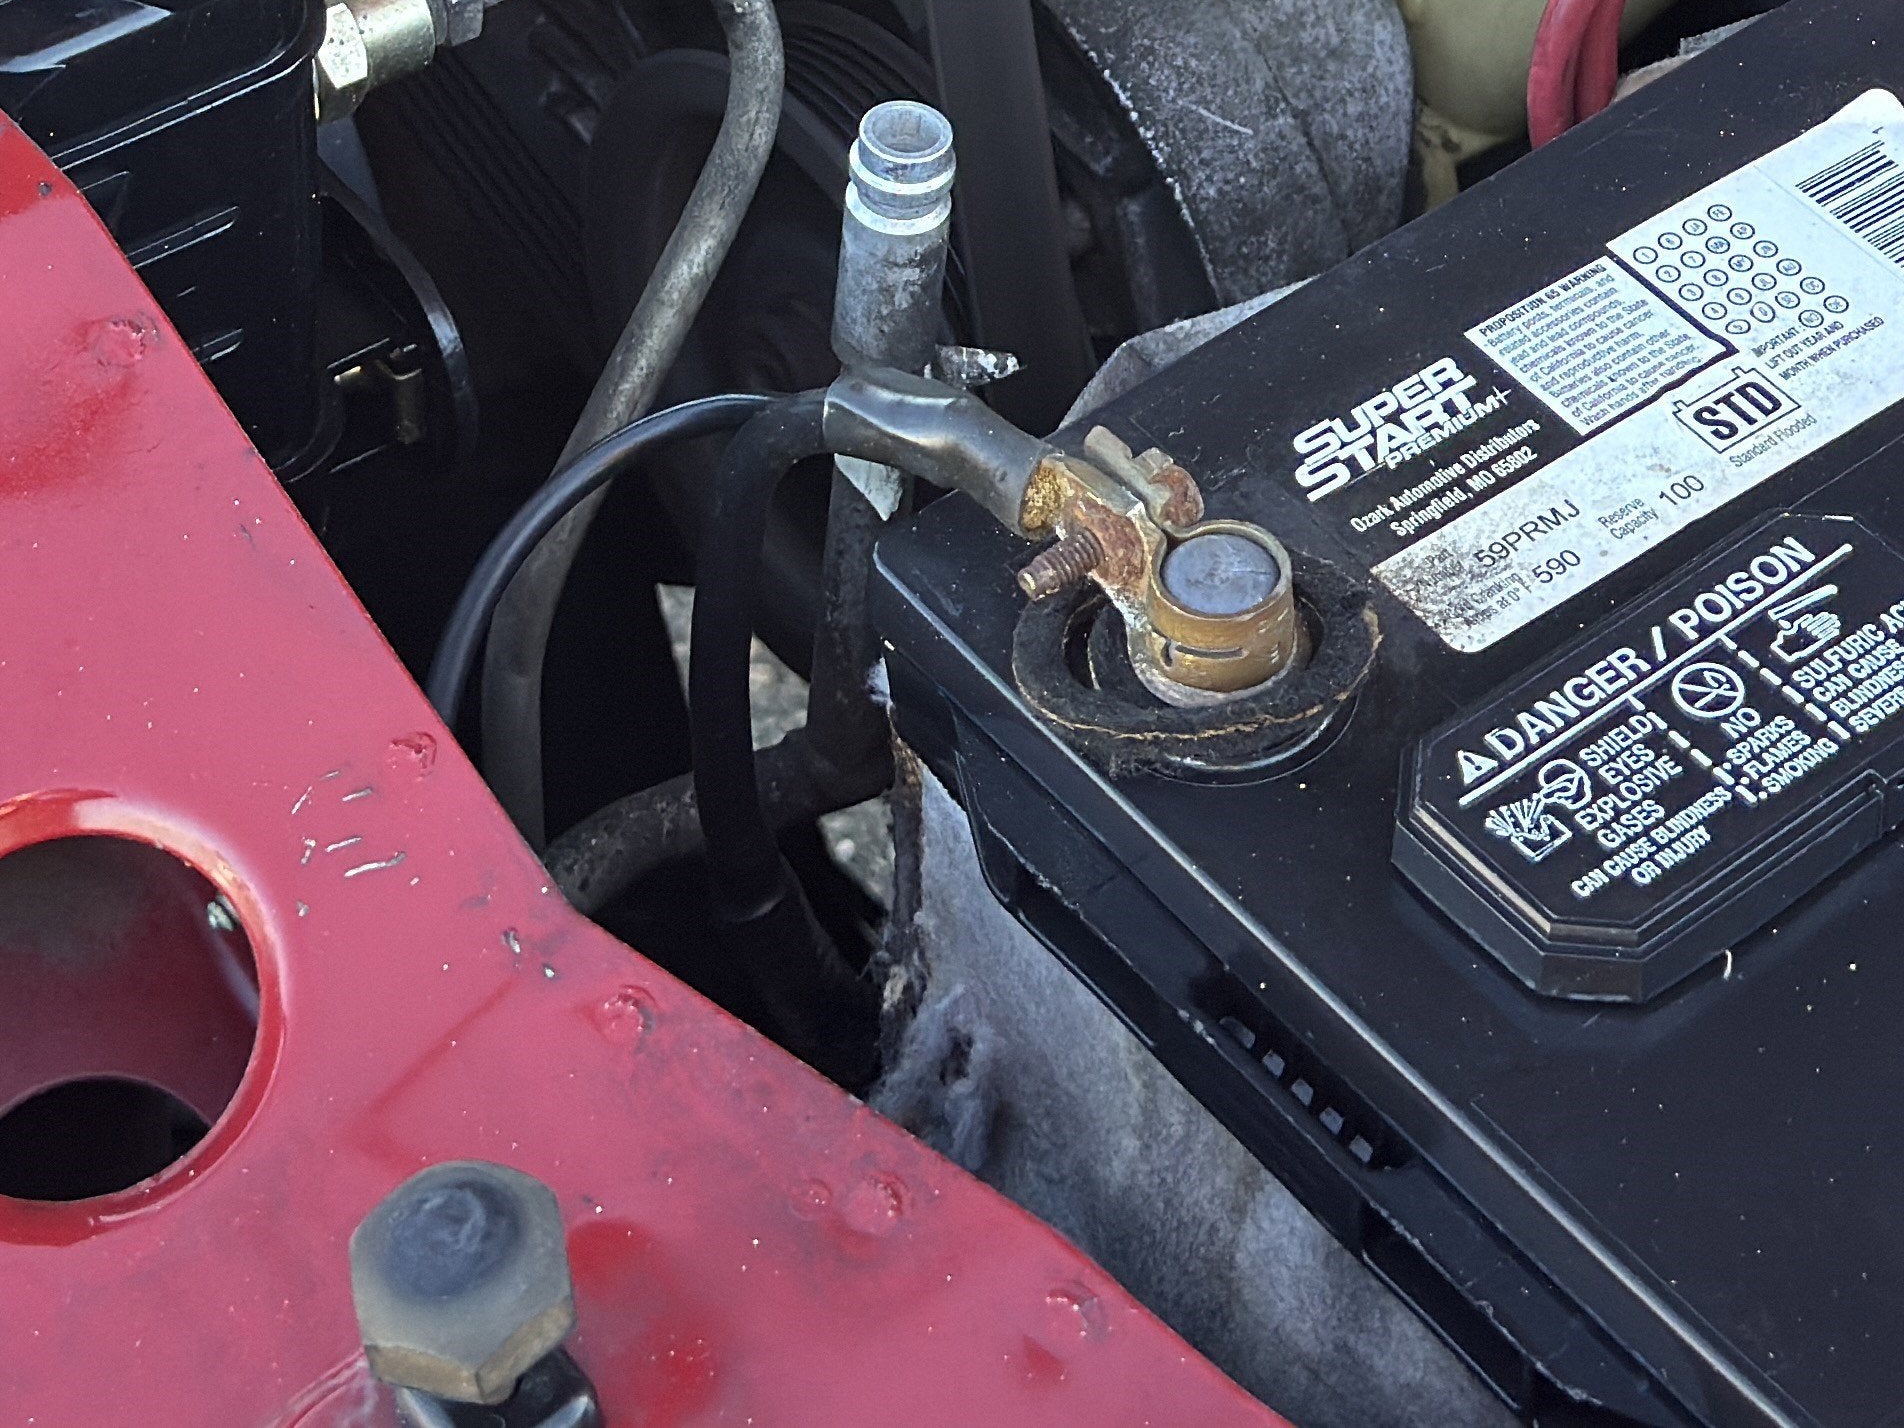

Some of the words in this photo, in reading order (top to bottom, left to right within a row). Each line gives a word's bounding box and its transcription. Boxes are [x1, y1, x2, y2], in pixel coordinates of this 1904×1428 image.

[1871, 126, 1883, 134] 1
[1478, 296, 1547, 337] PROPOSITION
[1544, 288, 1560, 299] 65
[1557, 264, 1606, 291] WARNING
[1764, 353, 1785, 369] LIFT
[1781, 343, 1803, 358] OUT
[1799, 331, 1826, 347] YEAR
[1823, 320, 1844, 335] AND
[1778, 358, 1811, 380] MONTH
[1807, 344, 1836, 362] WHEN
[1832, 316, 1884, 349] PURCHASED
[1292, 355, 1467, 459] SUPER
[1692, 381, 1782, 440] STD
[1295, 373, 1477, 502] START
[1728, 434, 1778, 467] Standard
[1772, 412, 1817, 441] Flooded
[1350, 504, 1394, 532] Ozark
[1389, 462, 1465, 511] Automotive
[1459, 419, 1540, 468] Distributors
[1389, 486, 1473, 536] Springfield,
[1465, 469, 1495, 491] MO
[1490, 445, 1537, 477] 65802
[1658, 475, 1704, 505] 100
[1473, 498, 1581, 570] 59PRMJ
[1597, 498, 1644, 528] Reserve
[1609, 507, 1659, 539] Capacity
[1531, 549, 1580, 583] 590
[1484, 647, 1651, 760] DANGER
[1651, 625, 1666, 661] /
[1668, 536, 1815, 640] POISON
[1791, 623, 1885, 688] SULFURIC
[1812, 673, 1852, 702] CAN
[1578, 715, 1652, 766] SHIELD
[1720, 707, 1761, 738] NO
[1726, 715, 1795, 764] SPARKS
[1597, 743, 1654, 784] EYES
[1742, 730, 1811, 780] FLAMES
[1761, 737, 1838, 792] SMOKING
[1574, 754, 1682, 830] EXPLOSIVE
[1571, 868, 1609, 896] CAN
[1602, 836, 1656, 876] CAUSE
[1649, 785, 1731, 844] BLINDNESS
[1596, 799, 1665, 848] GASES
[1631, 860, 1661, 884] OR
[1654, 825, 1710, 868] INJURY
